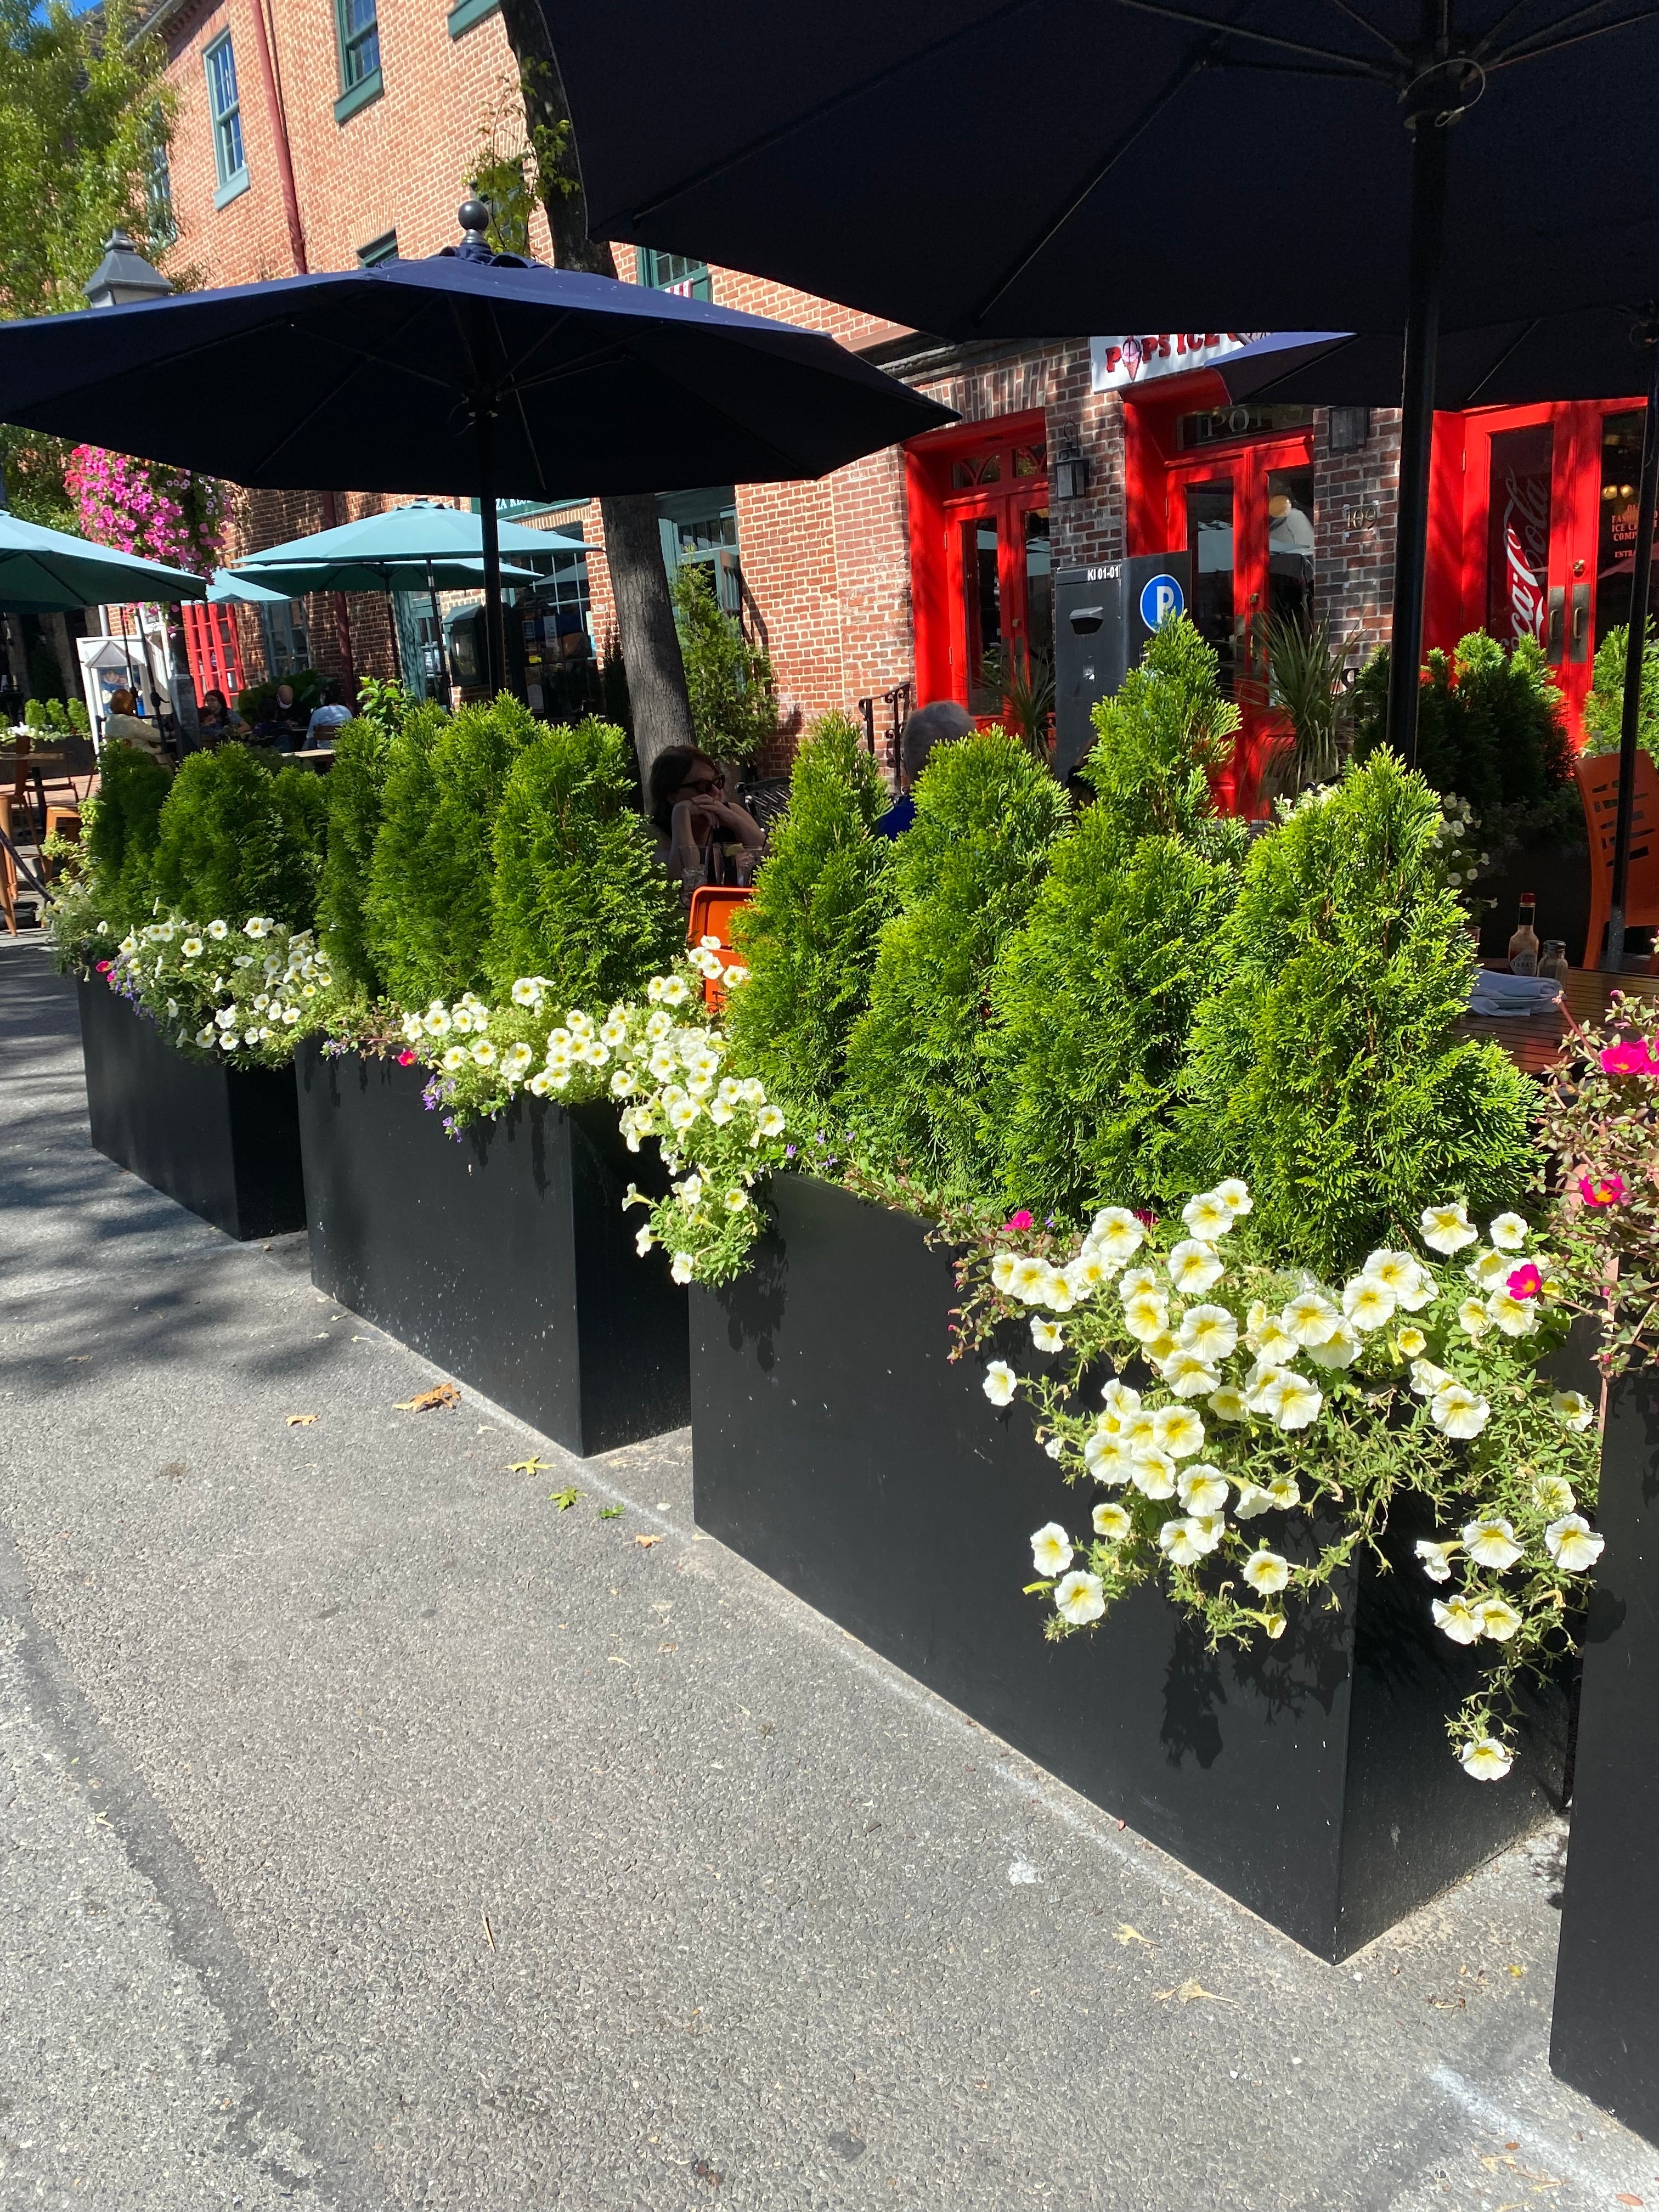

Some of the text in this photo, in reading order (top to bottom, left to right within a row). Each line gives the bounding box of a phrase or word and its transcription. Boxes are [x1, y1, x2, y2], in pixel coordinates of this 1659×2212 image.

[1347, 508, 1378, 531] 109
[1098, 566, 1119, 579] 01-01
[1156, 585, 1175, 624] P
